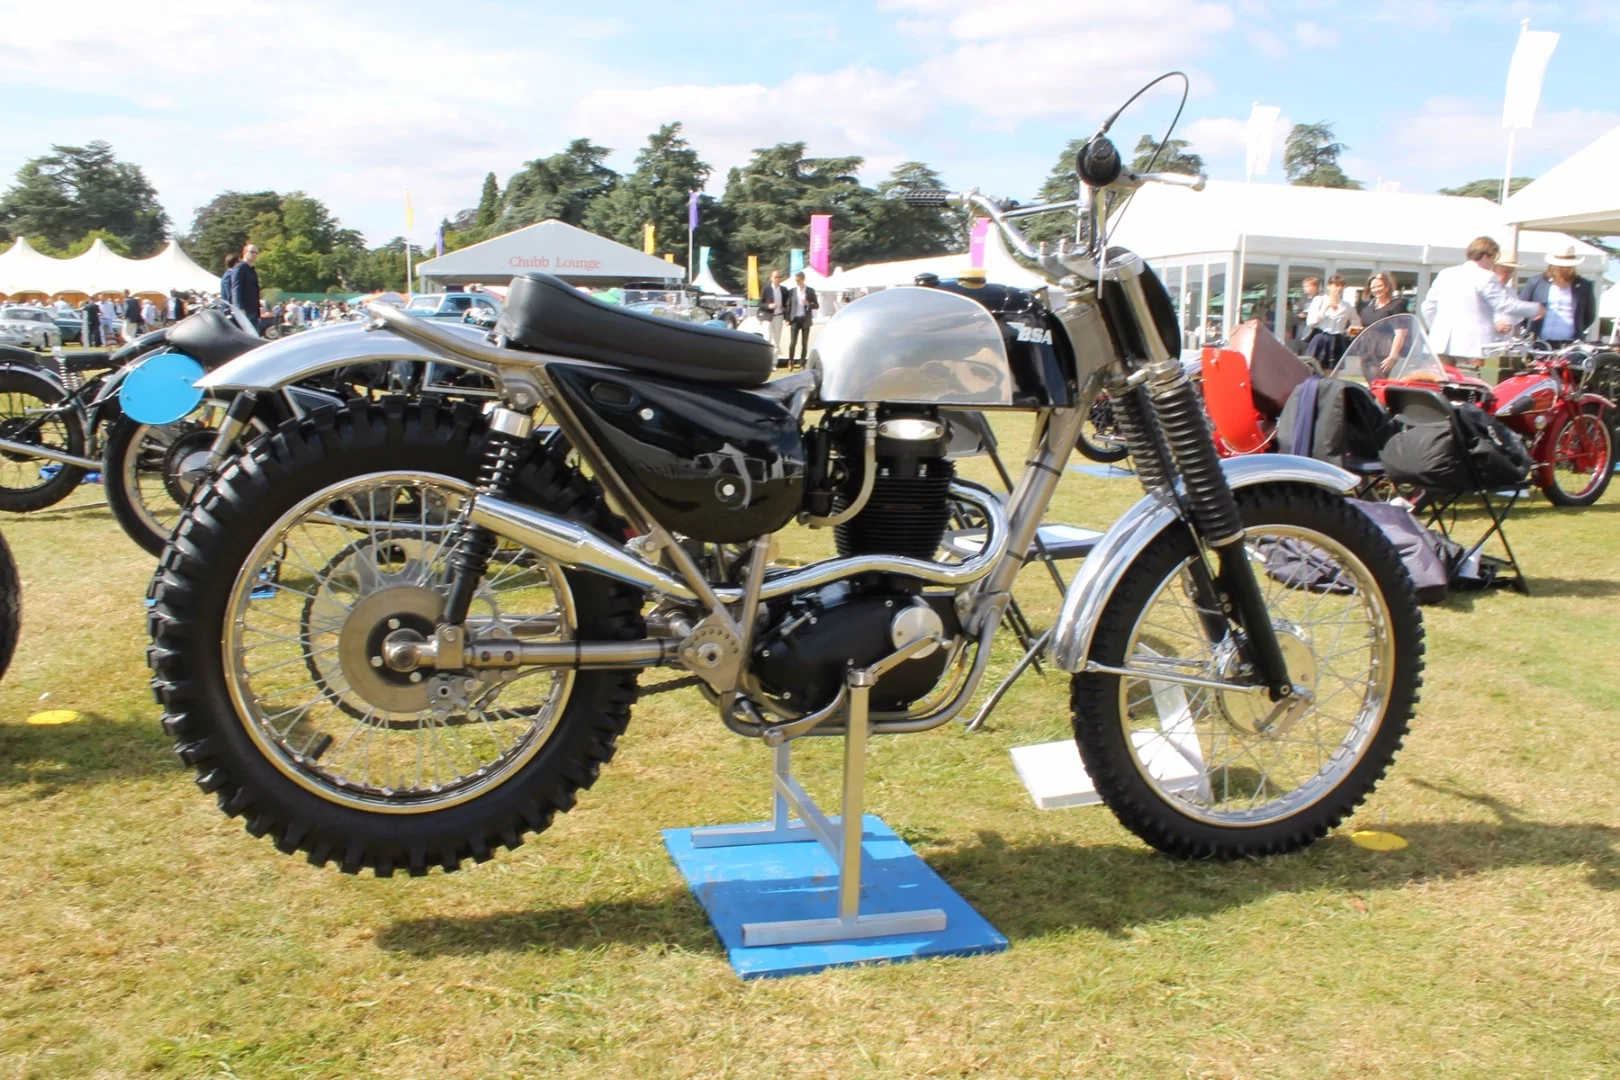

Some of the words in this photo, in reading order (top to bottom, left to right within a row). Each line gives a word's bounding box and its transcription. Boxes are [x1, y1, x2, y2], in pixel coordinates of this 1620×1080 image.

[509, 256, 549, 267] Chubb
[556, 257, 600, 271] Lounge
[1010, 322, 1053, 345] BSA
